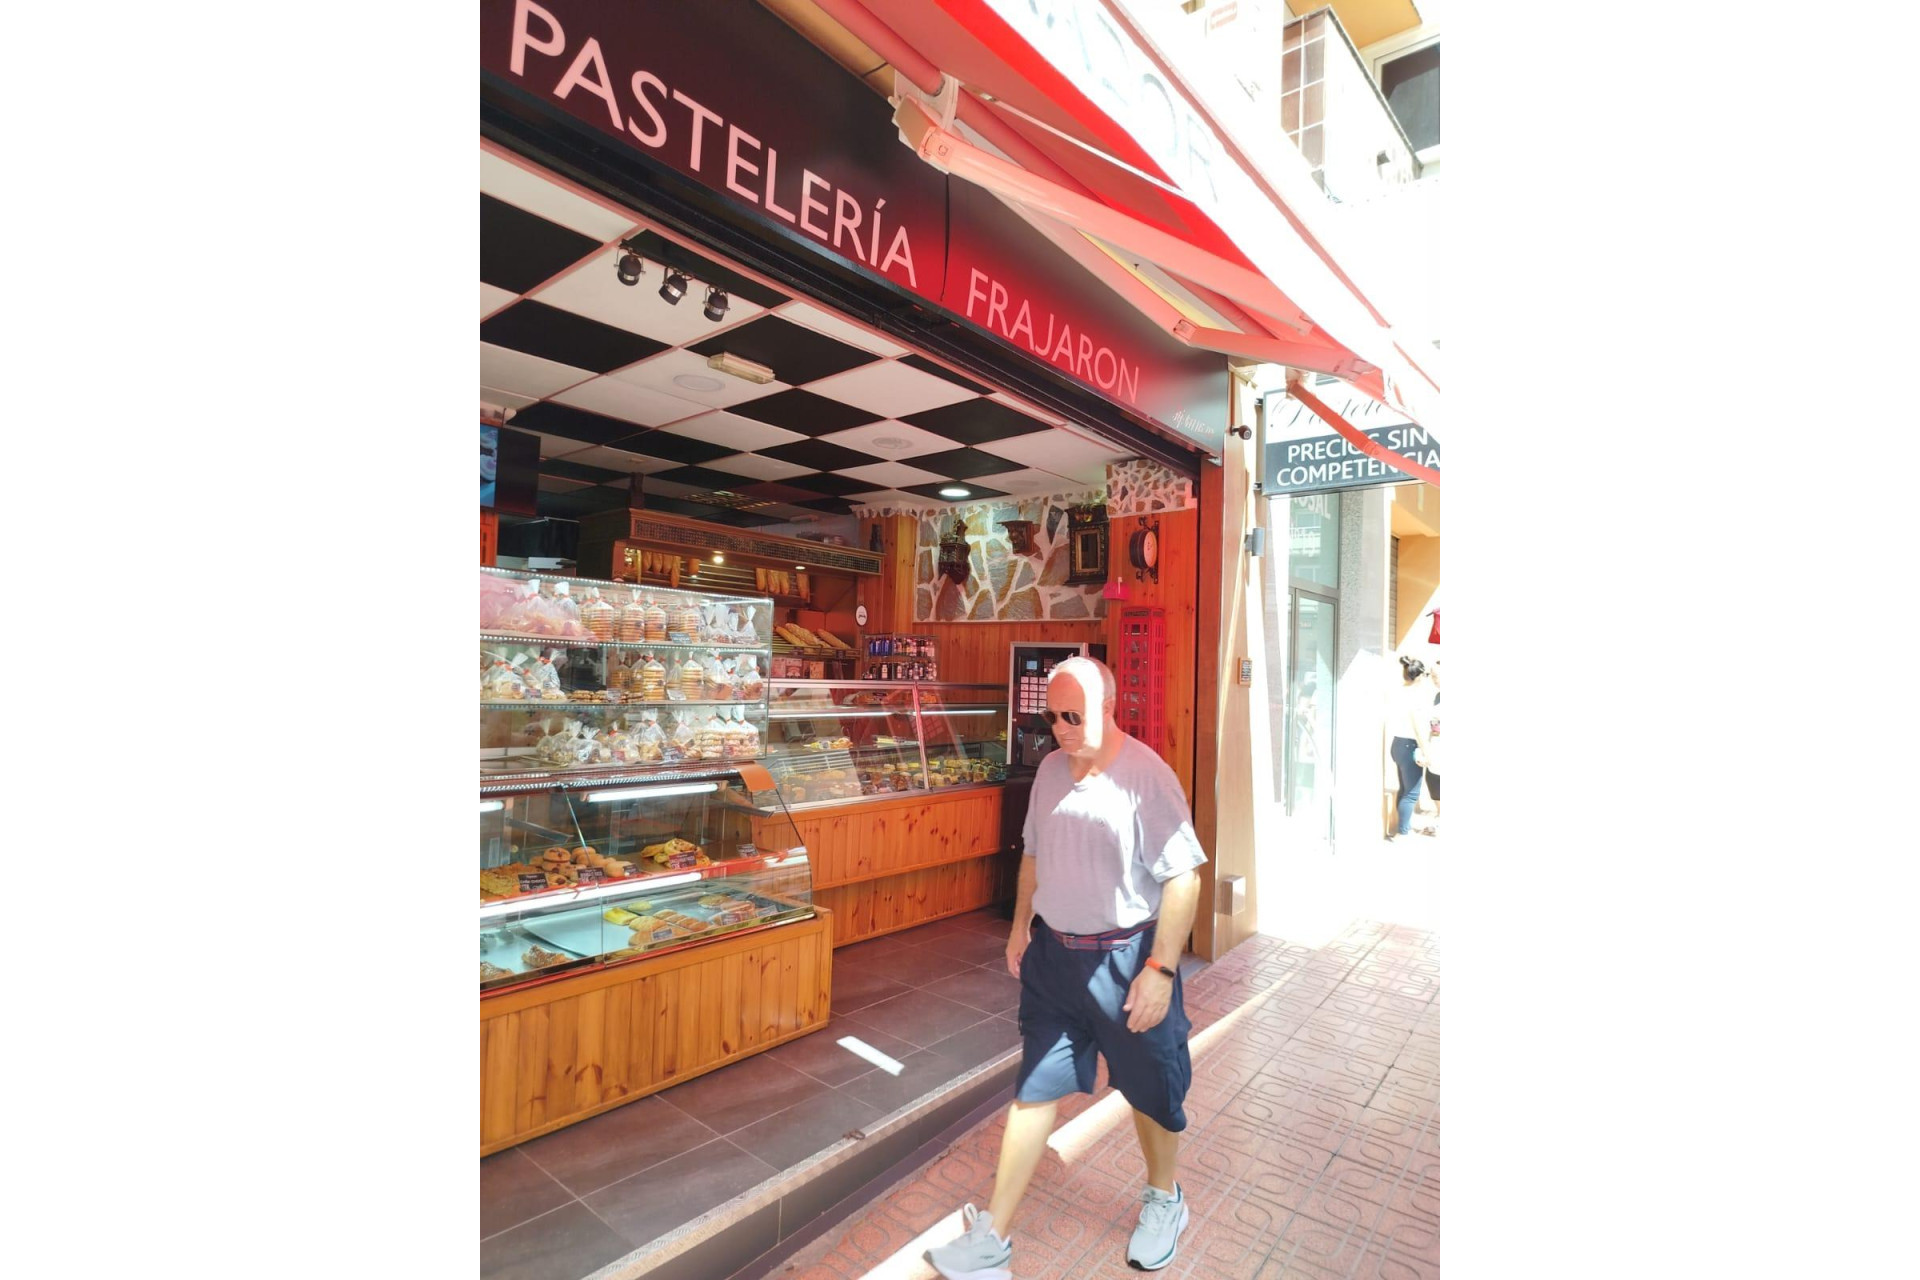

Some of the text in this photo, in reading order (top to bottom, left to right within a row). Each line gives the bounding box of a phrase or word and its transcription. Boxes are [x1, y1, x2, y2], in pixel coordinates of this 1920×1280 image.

[509, 0, 918, 289] PASTELERÍA
[965, 267, 1140, 404] FRAJARON
[1276, 449, 1440, 487] COMPETENIA
[1387, 427, 1429, 451] SIN
